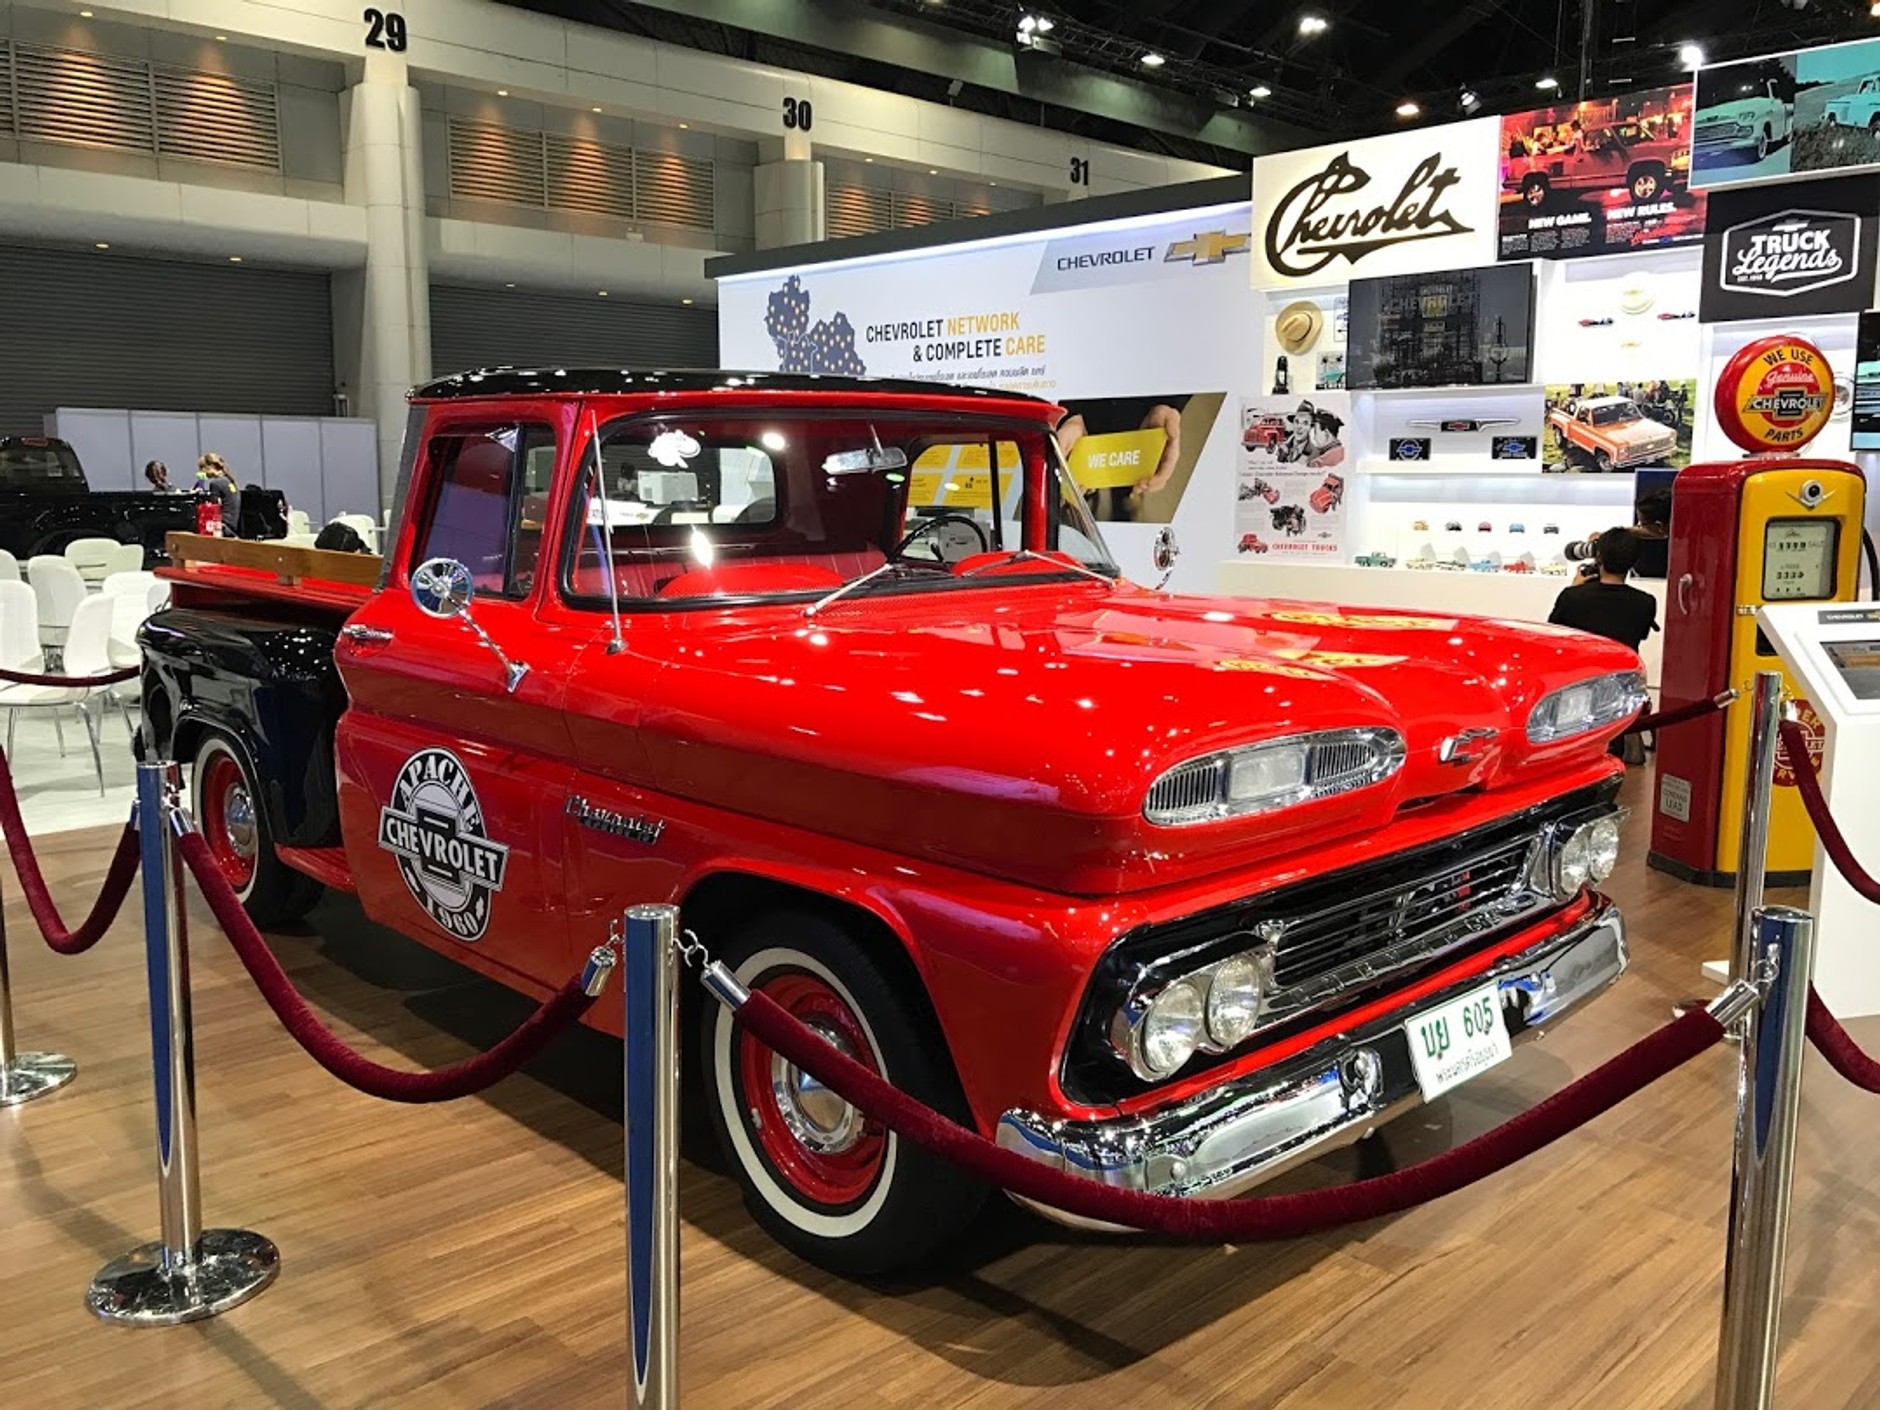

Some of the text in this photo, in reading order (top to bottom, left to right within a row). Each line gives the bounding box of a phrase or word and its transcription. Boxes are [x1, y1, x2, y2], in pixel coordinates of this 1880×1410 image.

[364, 7, 407, 52] 29
[783, 96, 812, 132] 30
[1070, 157, 1088, 186] 31
[1265, 151, 1475, 277] Chevrolet
[1528, 212, 1592, 229] NEW GAME.
[1606, 202, 1677, 220] NEW RULES.
[1751, 229, 1831, 256] TRUCK
[1057, 246, 1155, 271] CHEVROLET
[1732, 246, 1842, 283] Legends
[866, 312, 1020, 343] CHEVROLET NETWORK
[912, 335, 1046, 362] & COMPLETE CARE
[1763, 348, 1814, 366] WE USE
[1753, 397, 1826, 410] CHEVROLET
[1764, 427, 1804, 443] PARTS
[1088, 450, 1141, 469] WE CARE
[400, 755, 480, 832] APACHE
[386, 817, 498, 882] CHEVROLET
[426, 895, 480, 936] 1960
[1463, 996, 1494, 1039] 605
